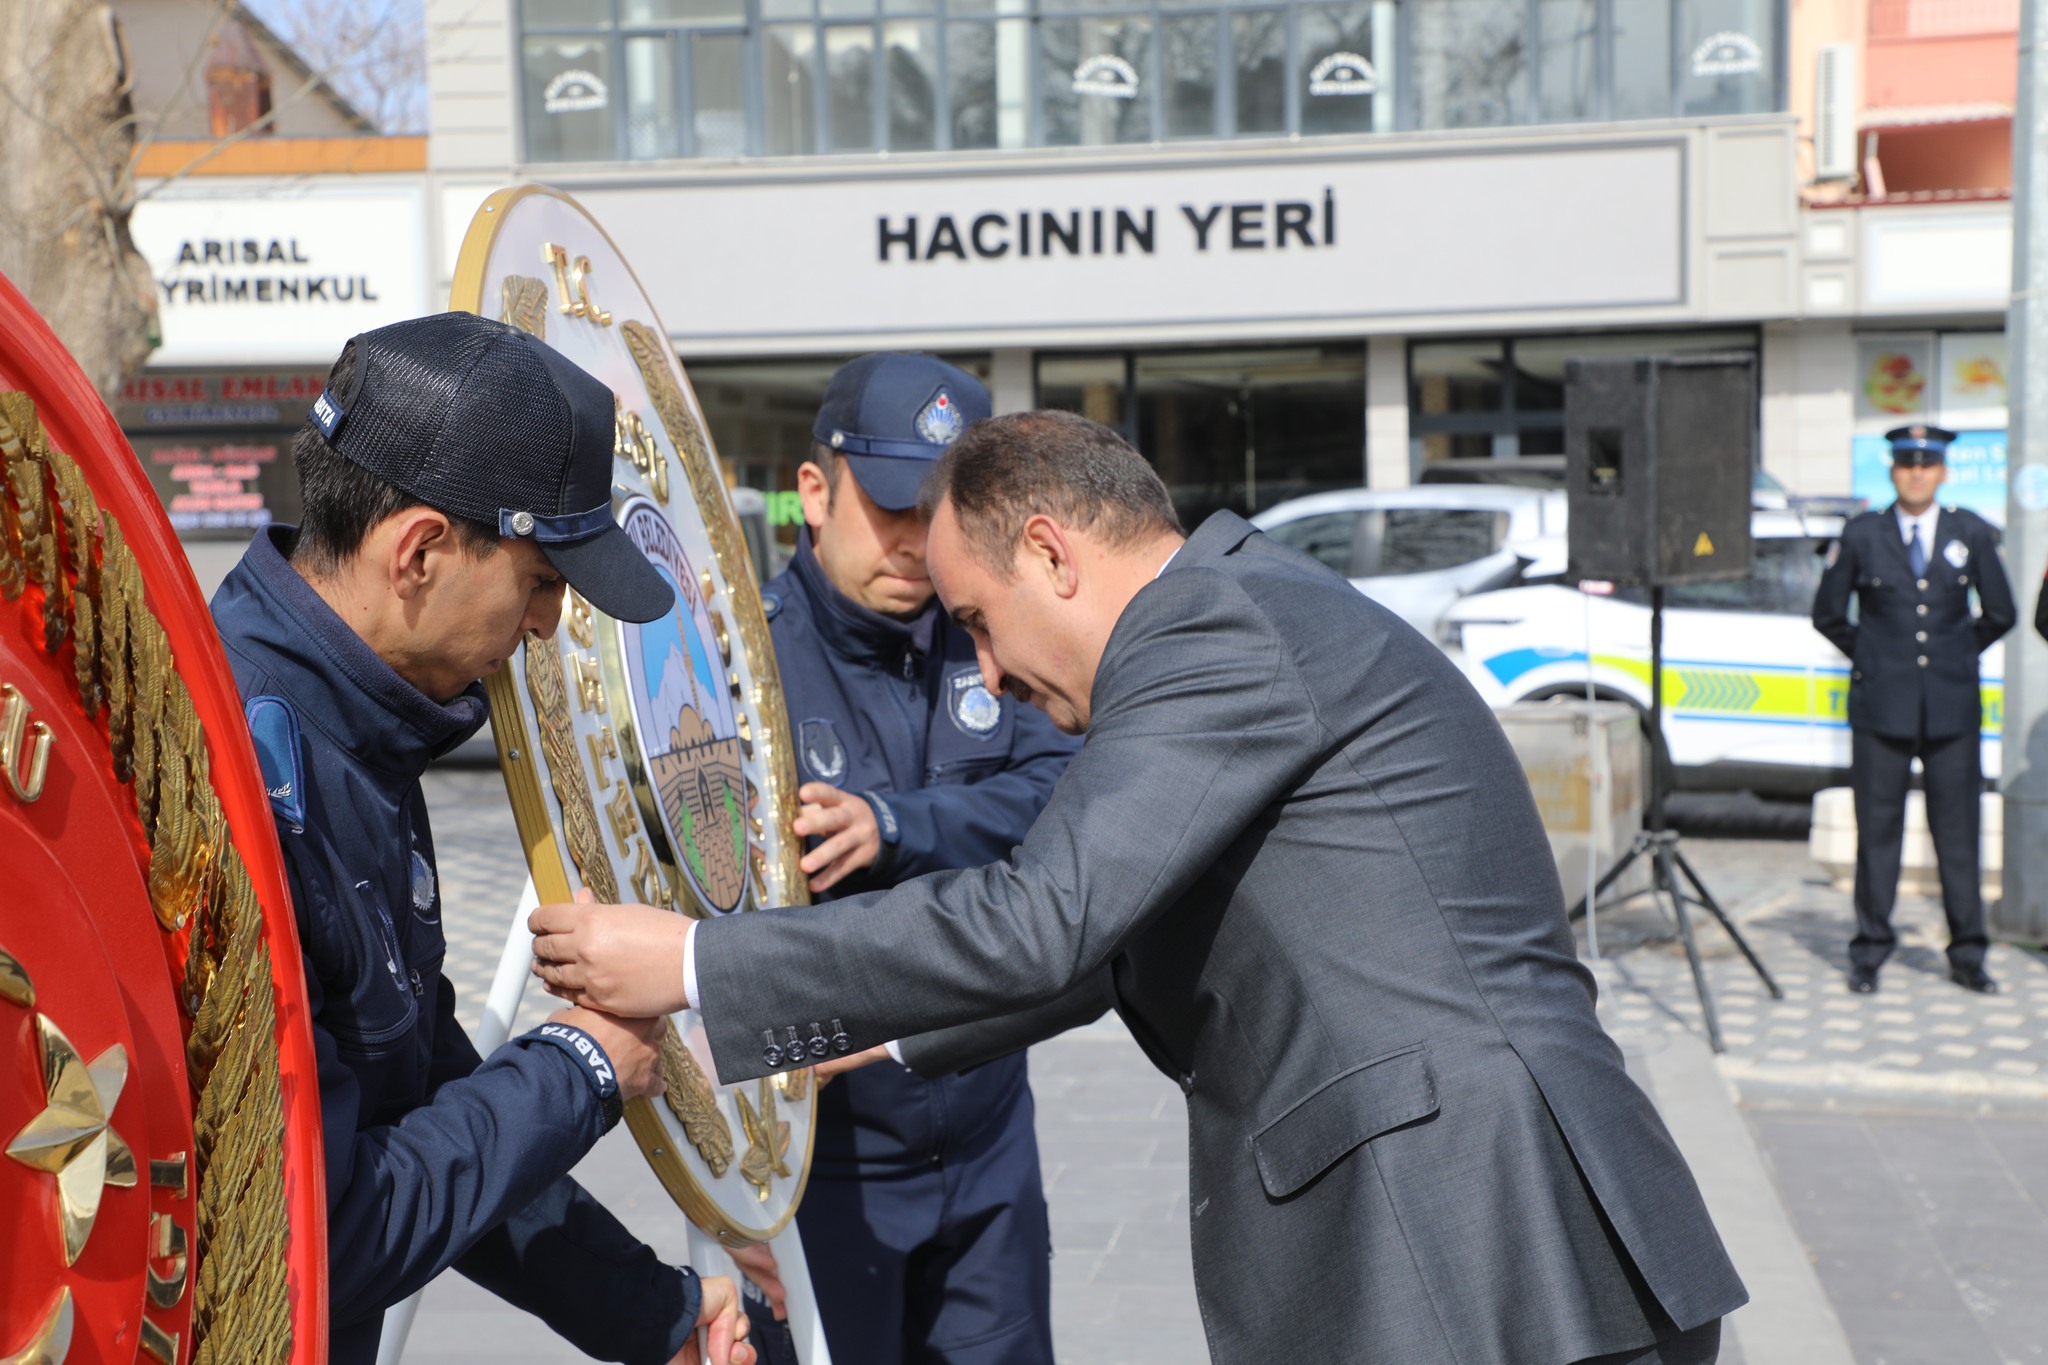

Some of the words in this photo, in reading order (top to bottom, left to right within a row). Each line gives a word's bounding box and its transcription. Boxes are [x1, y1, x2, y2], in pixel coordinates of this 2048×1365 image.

[878, 208, 1155, 262] HACININ
[1181, 187, 1334, 251] YERİ
[178, 239, 309, 265] ARISAL
[160, 274, 378, 302] YRİMENKUL
[540, 1025, 613, 1086] ZABITA
